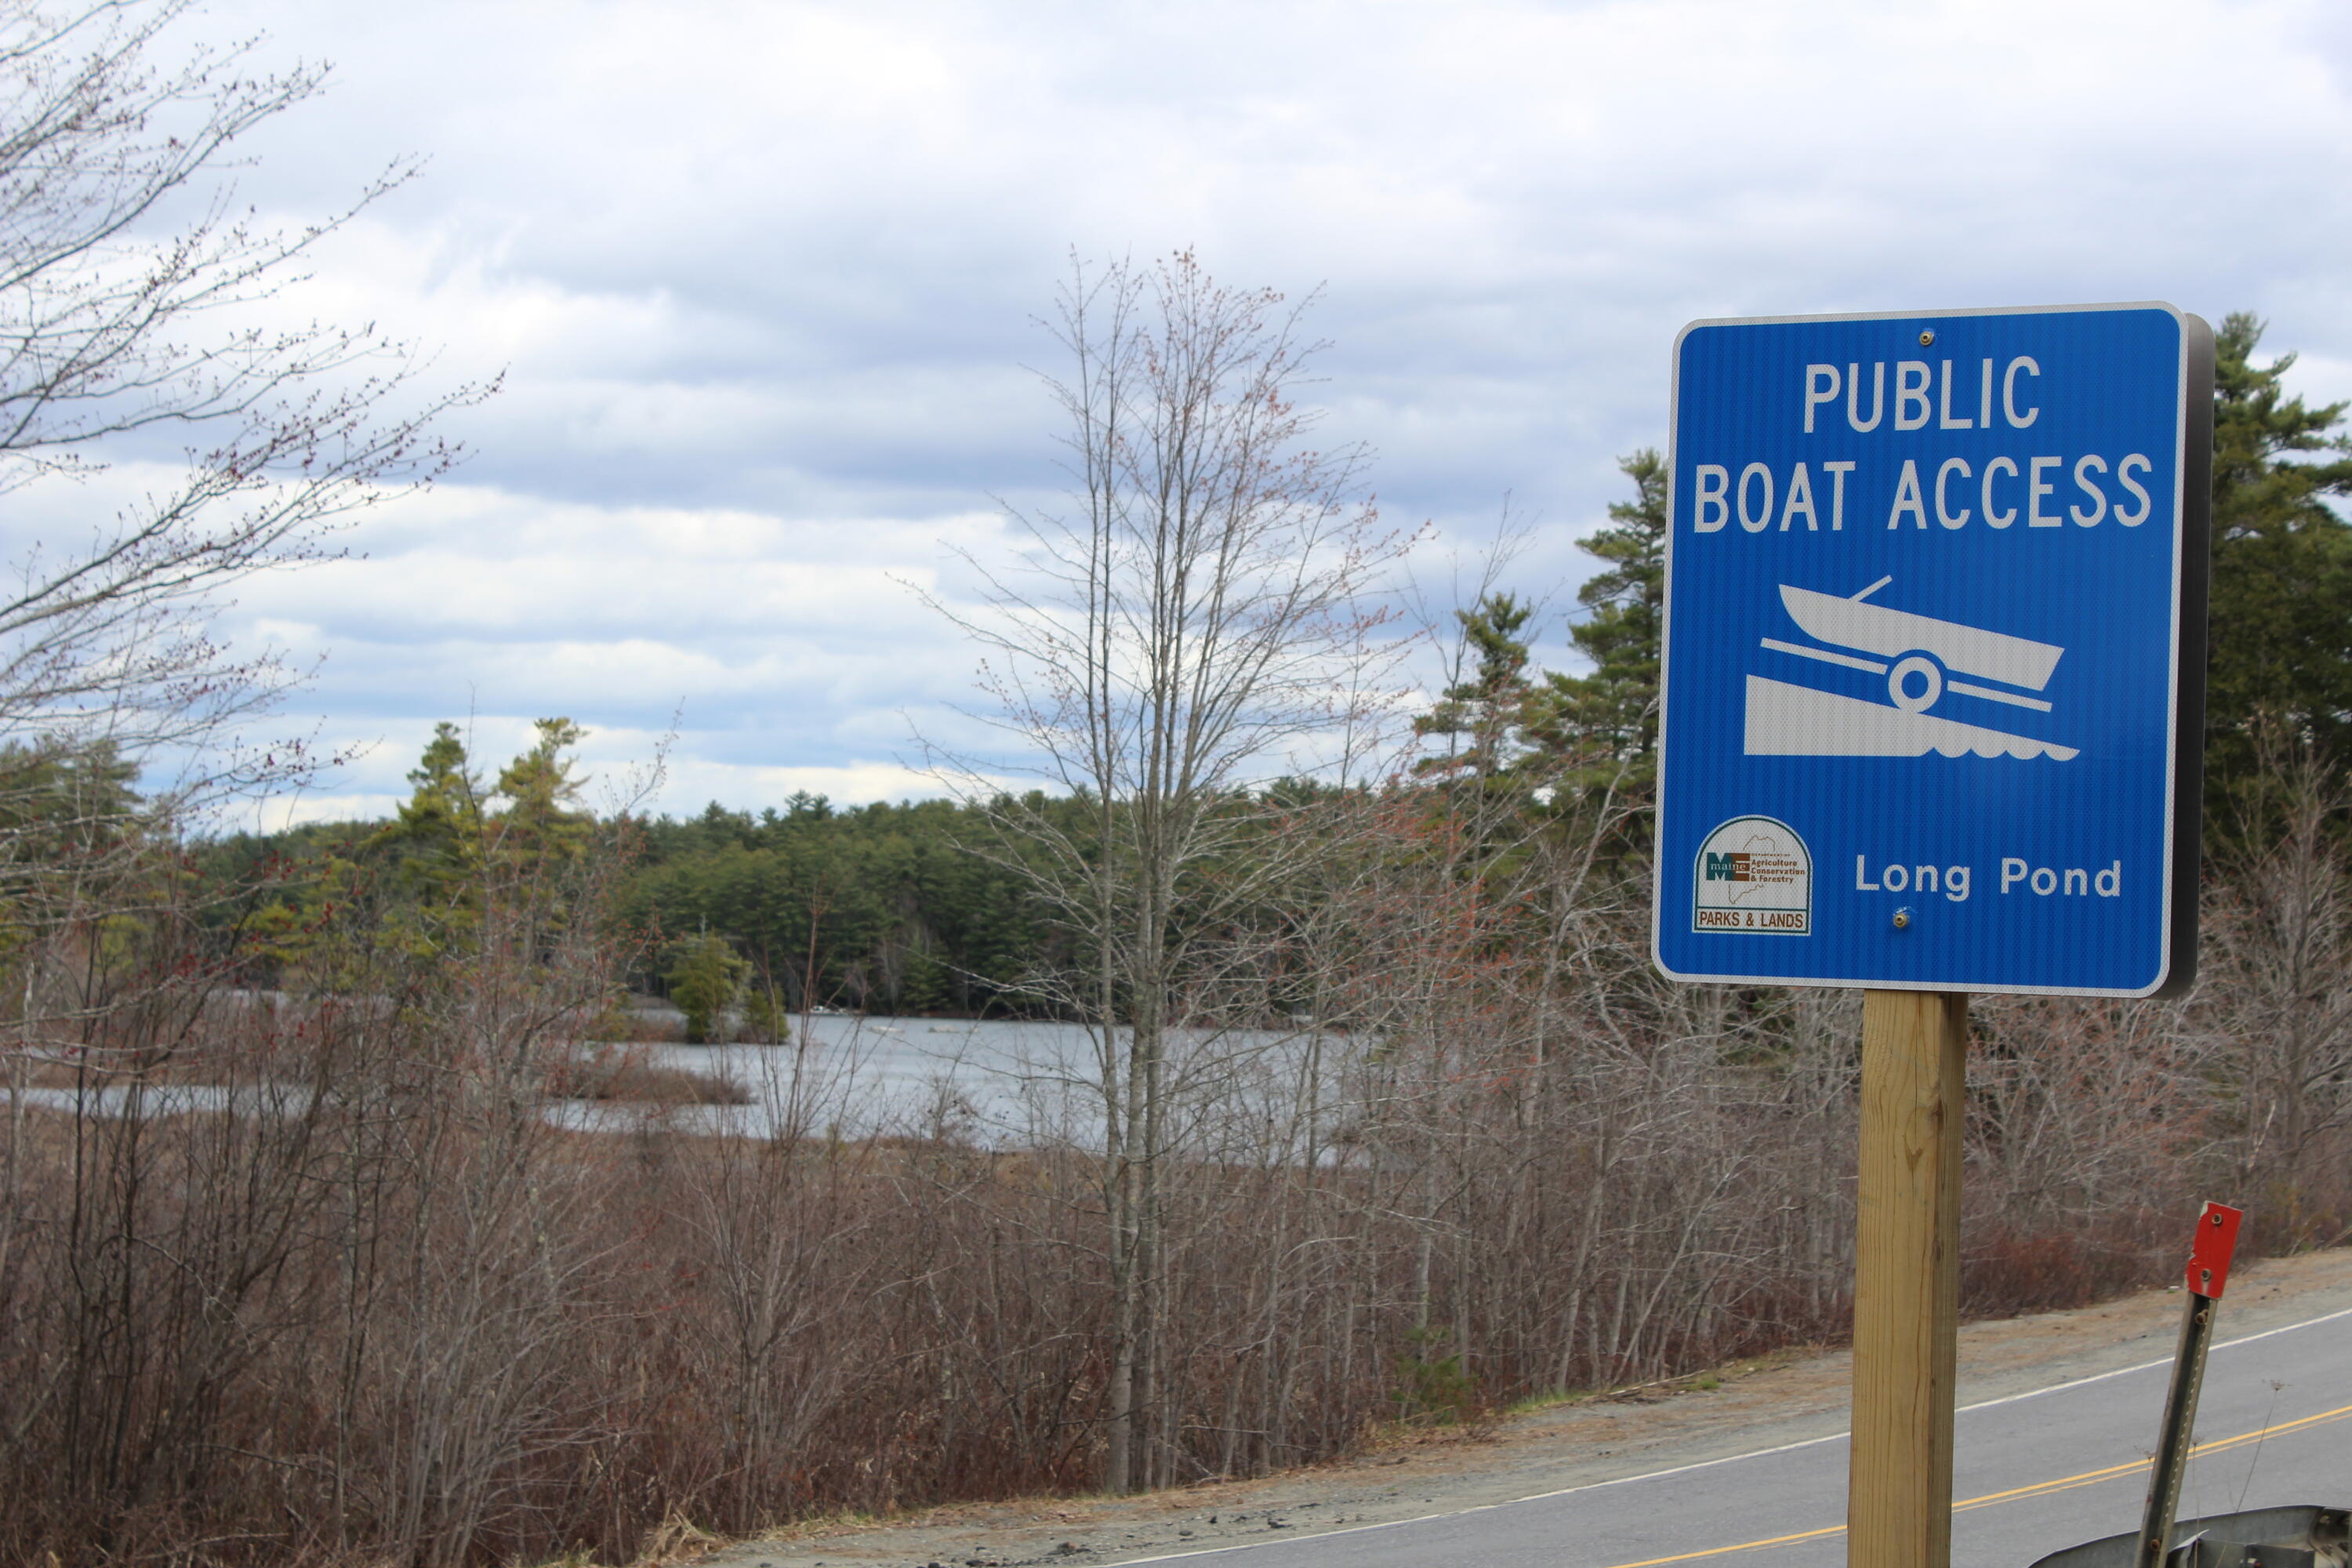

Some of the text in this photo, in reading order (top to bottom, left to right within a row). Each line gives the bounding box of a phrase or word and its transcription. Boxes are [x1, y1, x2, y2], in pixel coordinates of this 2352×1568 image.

[1804, 355, 2041, 434] PUBLIC
[1693, 453, 2153, 533] BOAT ACCESS
[1711, 861, 1746, 871] maine
[1751, 858, 1798, 868] Agriculture
[1751, 867, 1806, 876] Conservation
[1759, 875, 1795, 884] Forestry
[1856, 855, 2122, 902] Long Pond
[1700, 911, 1804, 928] PARKS & LANDS
